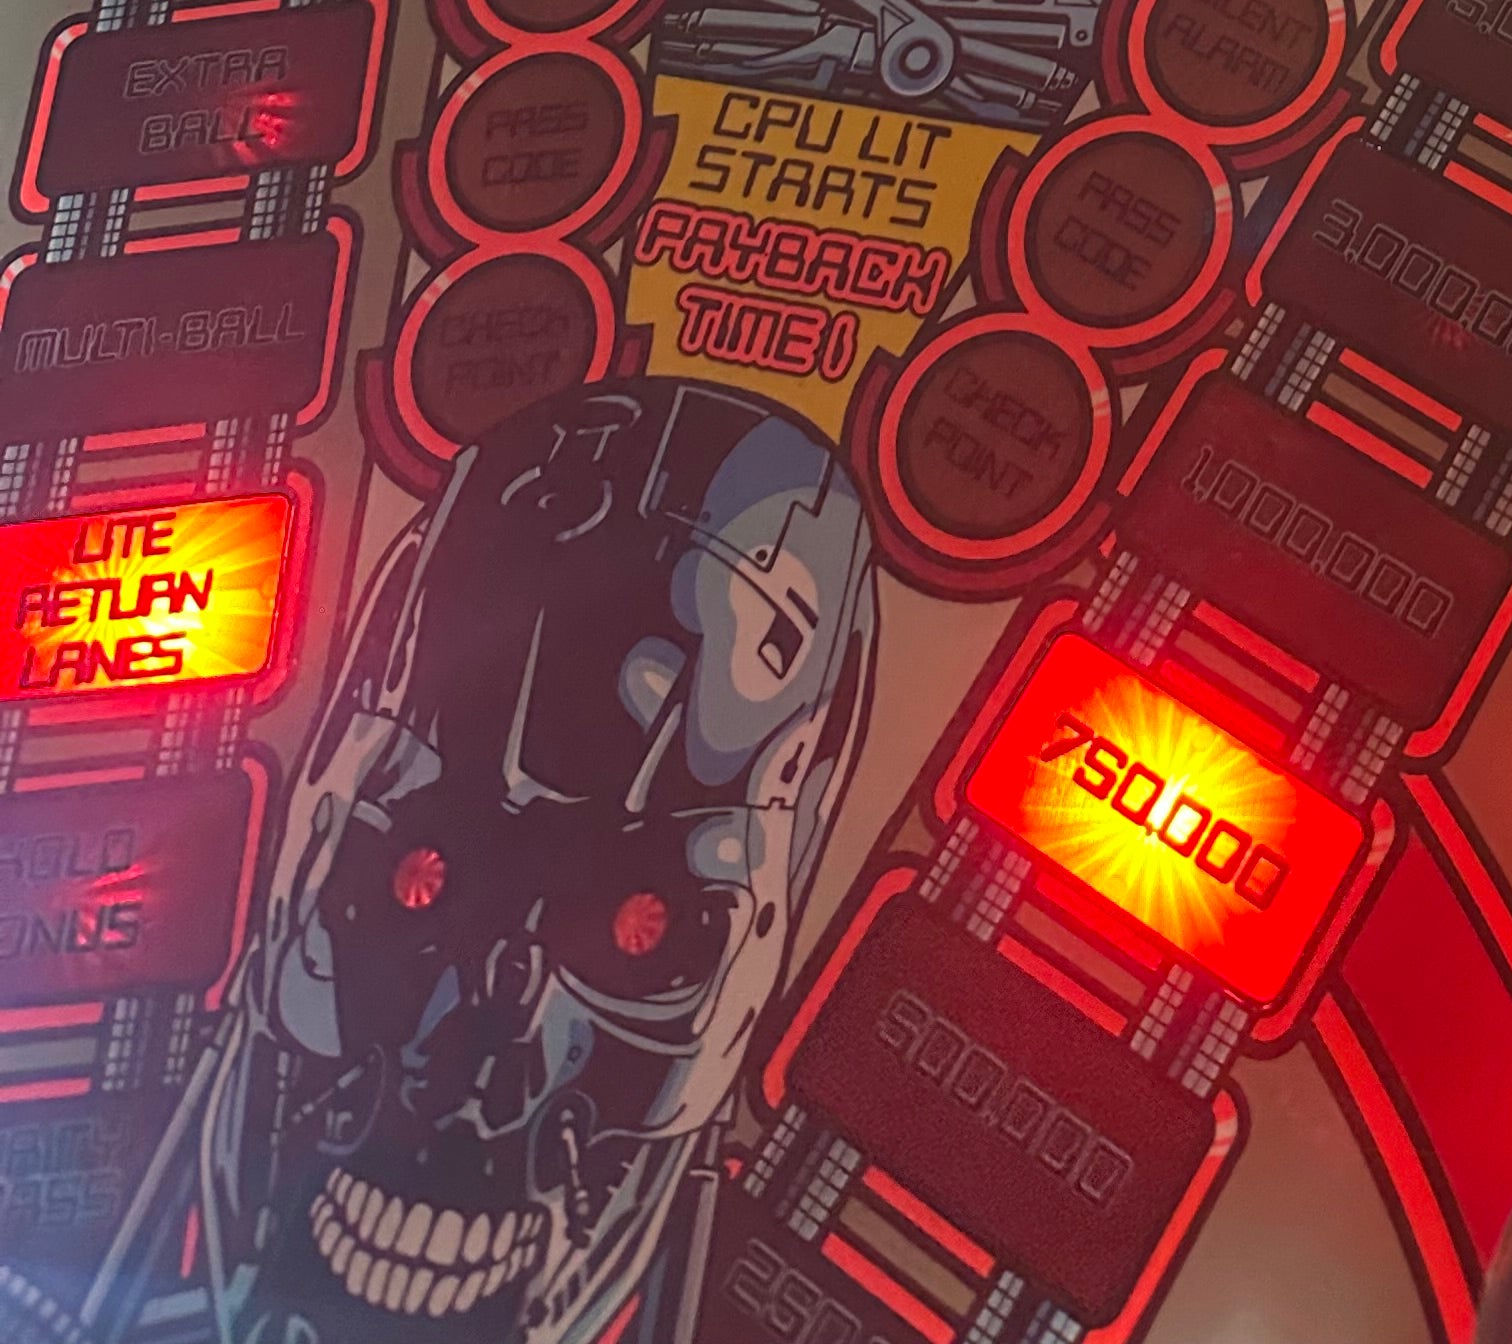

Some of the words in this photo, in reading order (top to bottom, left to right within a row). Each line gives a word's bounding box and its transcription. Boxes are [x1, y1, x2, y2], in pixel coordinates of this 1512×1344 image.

[123, 45, 289, 101] EXTRA
[1164, 12, 1292, 96] ALARM
[138, 105, 264, 155] BALL
[485, 100, 589, 141] PASS
[712, 91, 844, 154] CPU
[858, 115, 953, 170] LIT
[479, 147, 582, 188] CODE
[687, 144, 939, 229] STARTS
[1077, 169, 1183, 250] PASS
[637, 201, 951, 312] PAYBACK
[1053, 214, 1154, 293] CODE
[15, 302, 307, 375] MULTI-BALL
[943, 366, 1071, 463] CHECK
[921, 416, 1035, 499] POINT
[72, 511, 177, 565] LITE
[15, 567, 215, 630] RETURN
[18, 630, 187, 690] LANES
[1038, 710, 1293, 914] 750,000
[0, 902, 145, 959] ONUS
